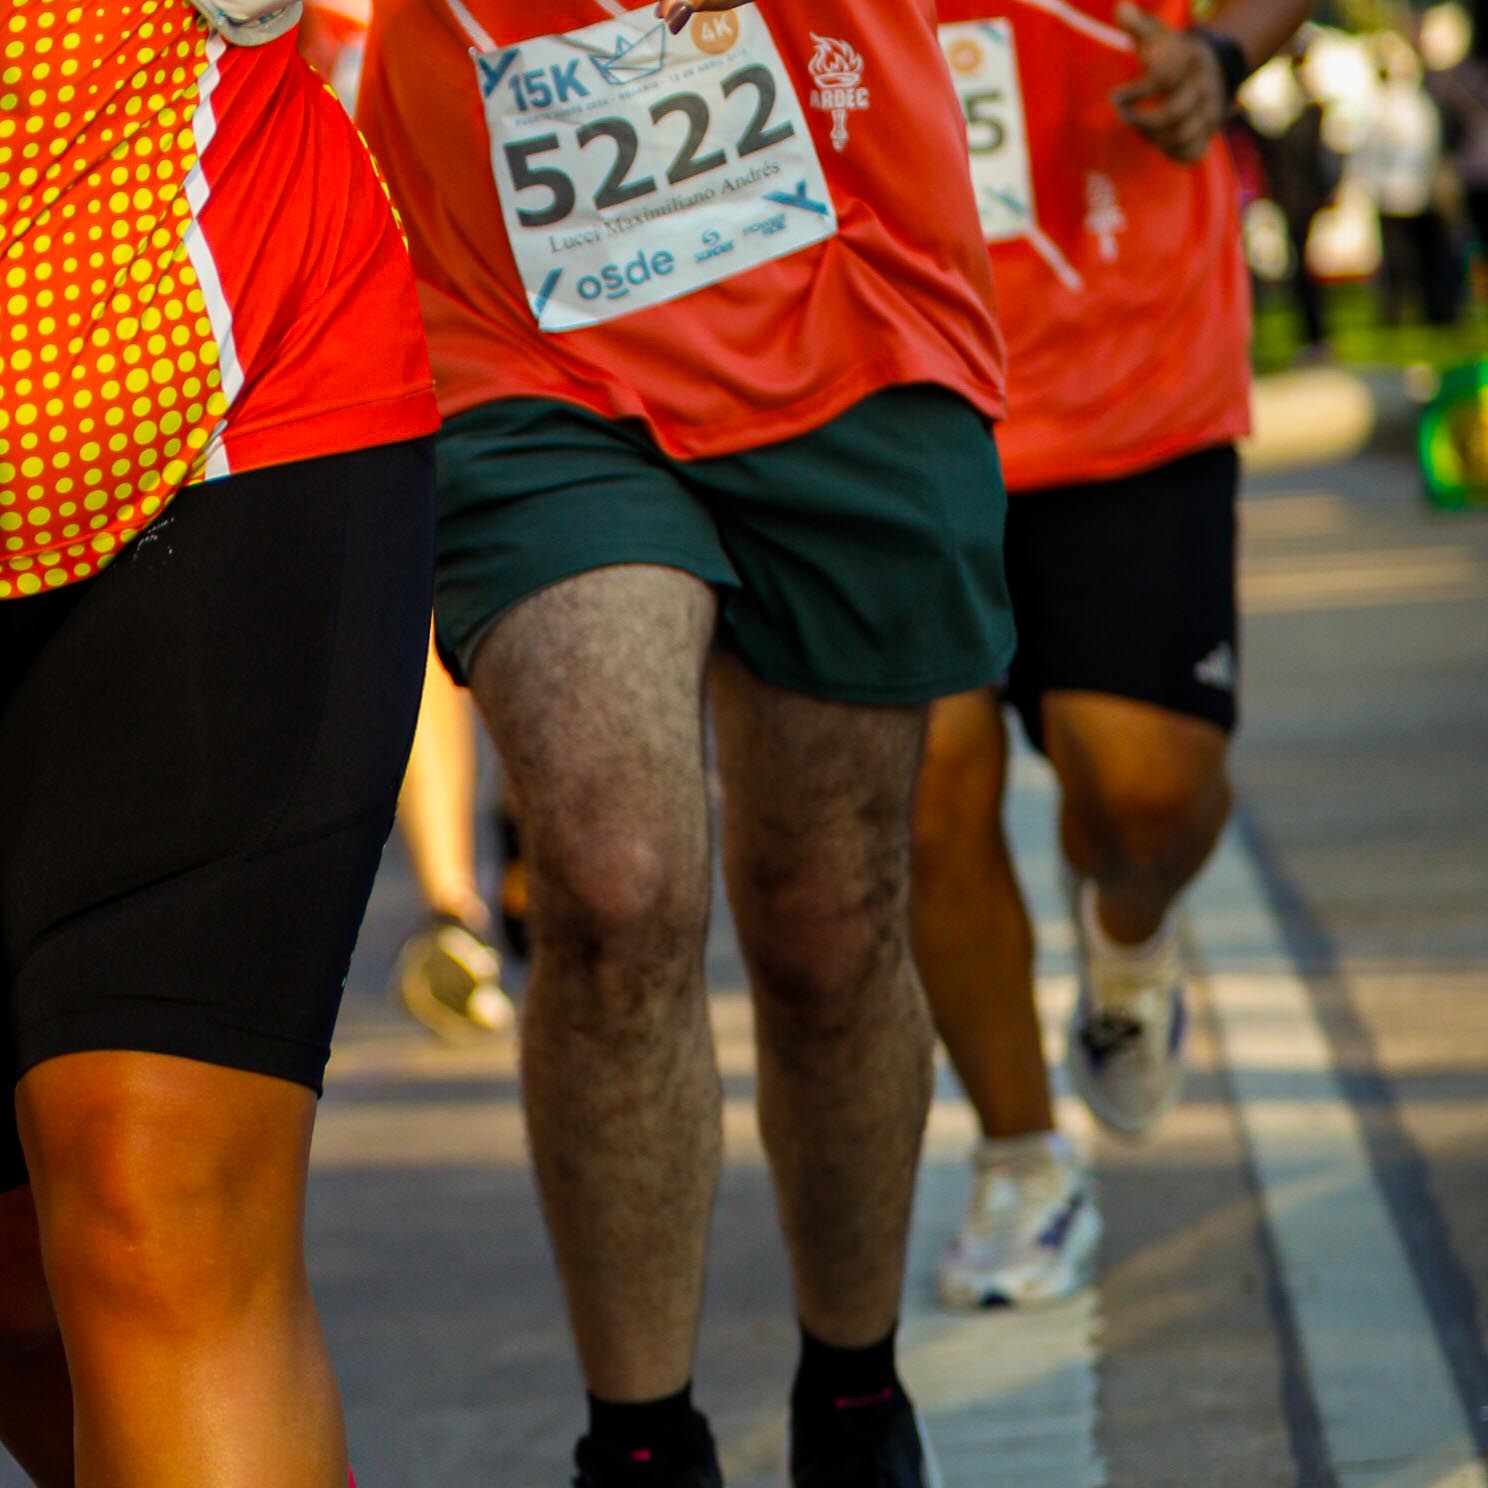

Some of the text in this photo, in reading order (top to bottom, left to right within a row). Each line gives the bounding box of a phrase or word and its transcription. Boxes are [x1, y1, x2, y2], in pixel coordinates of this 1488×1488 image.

[508, 57, 590, 112] 15K
[811, 86, 870, 110] ARDEC
[503, 62, 796, 228] 5222
[549, 228, 602, 254] Lucci
[603, 188, 715, 238] Maximiliano
[720, 160, 781, 197] Andrés
[576, 249, 675, 300] osde
